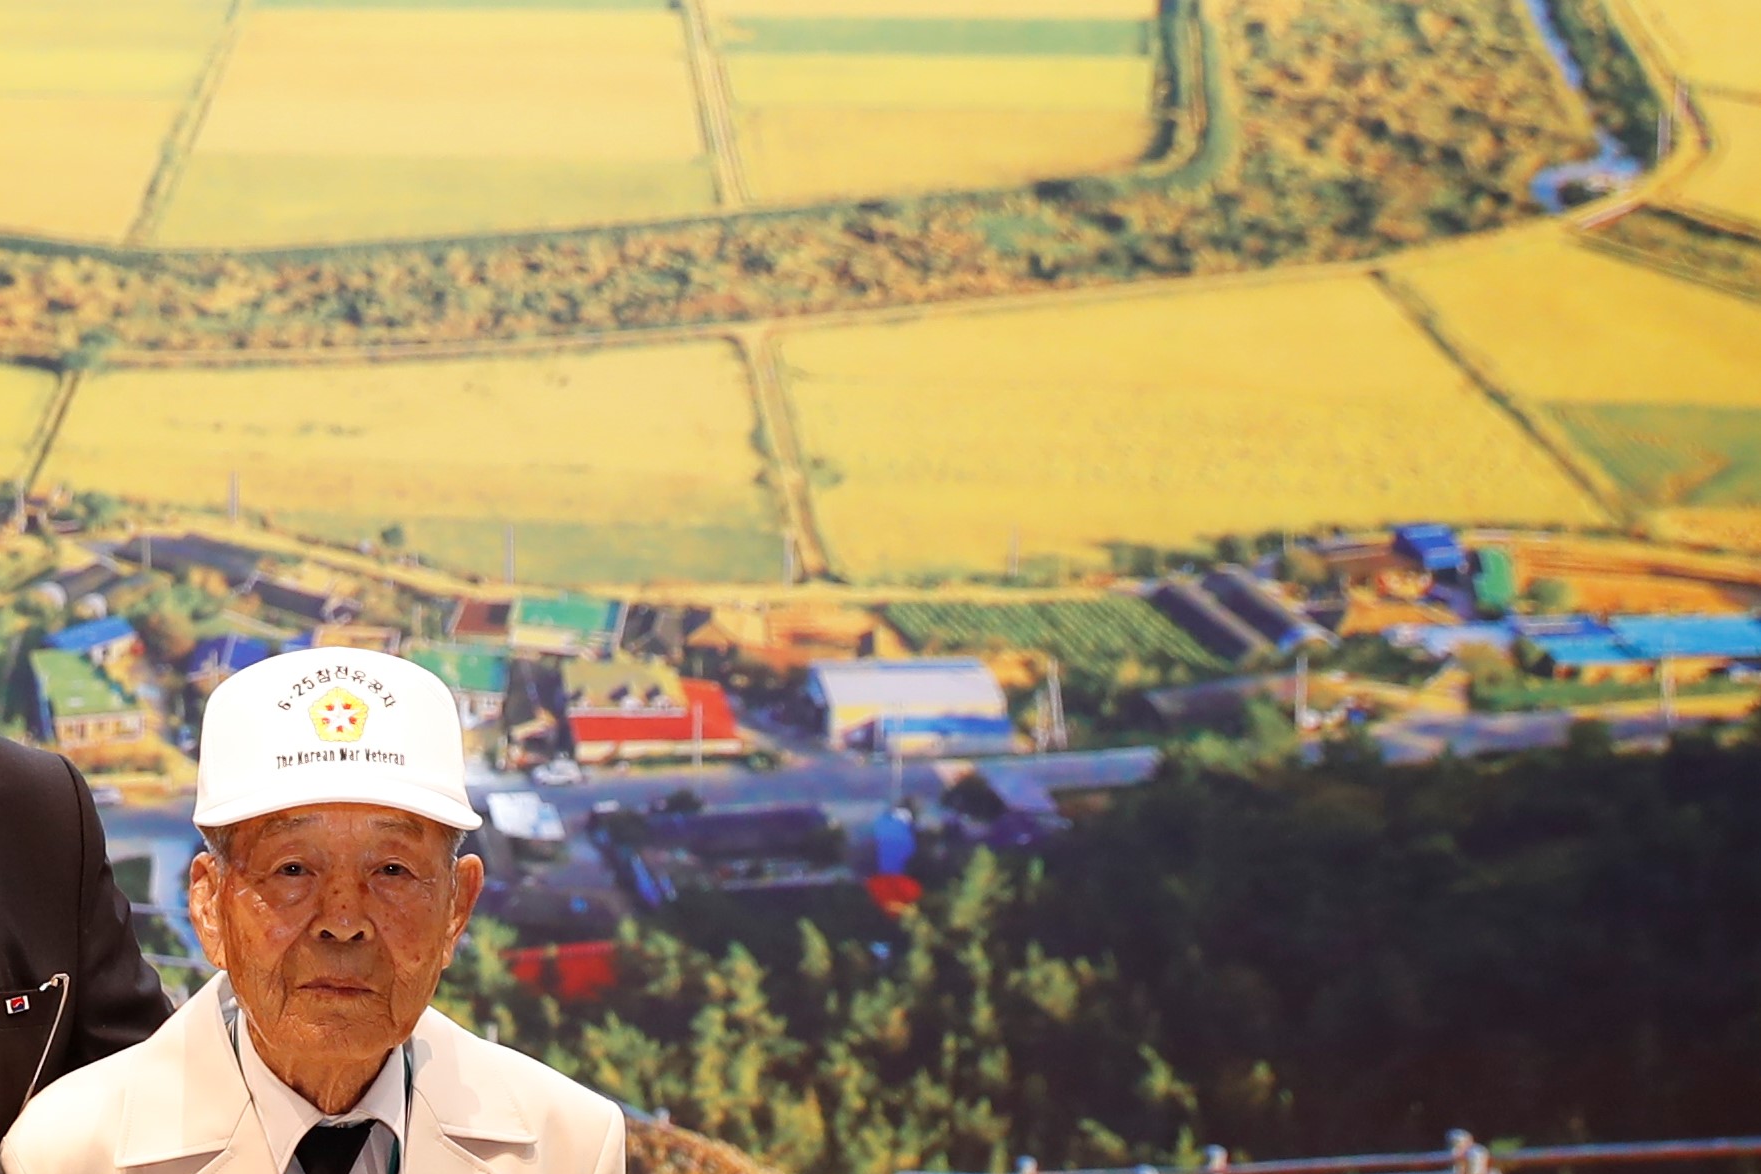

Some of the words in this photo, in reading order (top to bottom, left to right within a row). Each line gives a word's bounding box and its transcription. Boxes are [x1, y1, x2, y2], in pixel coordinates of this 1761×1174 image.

[276, 755, 294, 770] The
[297, 750, 336, 766] Korean
[339, 748, 360, 762] War
[364, 748, 406, 766] Veteran
